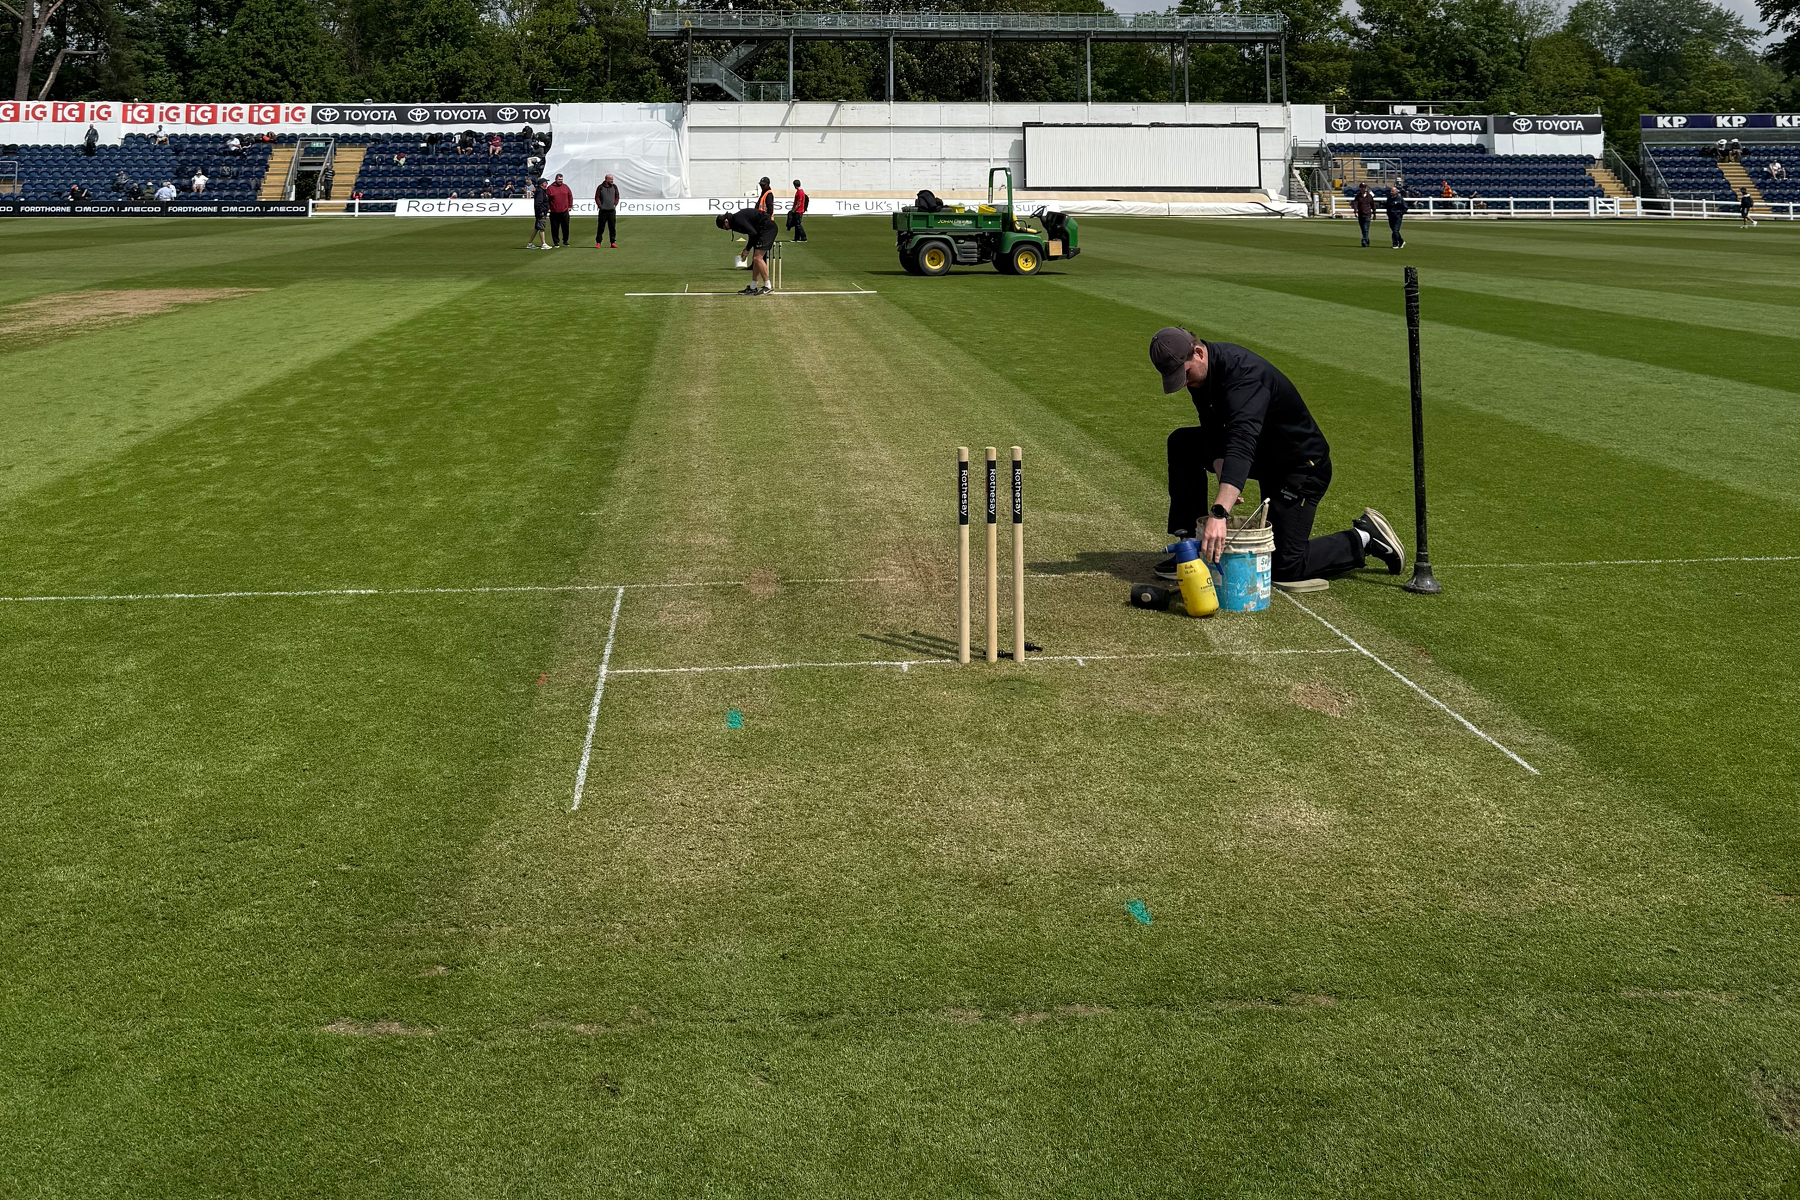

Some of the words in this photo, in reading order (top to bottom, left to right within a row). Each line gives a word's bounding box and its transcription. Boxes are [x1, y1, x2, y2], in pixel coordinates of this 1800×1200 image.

[0, 104, 14, 121] G
[343, 110, 397, 121] TOYOTA
[433, 109, 487, 121] TOYOTA
[522, 109, 550, 120] TOY
[1354, 119, 1404, 131] TOYOTA
[1433, 120, 1482, 131] TOYOTA
[1536, 120, 1585, 131] TOYOTA
[1656, 116, 1688, 128] KP
[1716, 115, 1747, 128] KP
[407, 200, 513, 215] Rothesay
[619, 201, 681, 212] Pensions
[708, 198, 795, 211] Rothsa
[836, 201, 860, 211] The
[960, 469, 968, 515] Rothesay
[988, 468, 996, 515] Rothesay
